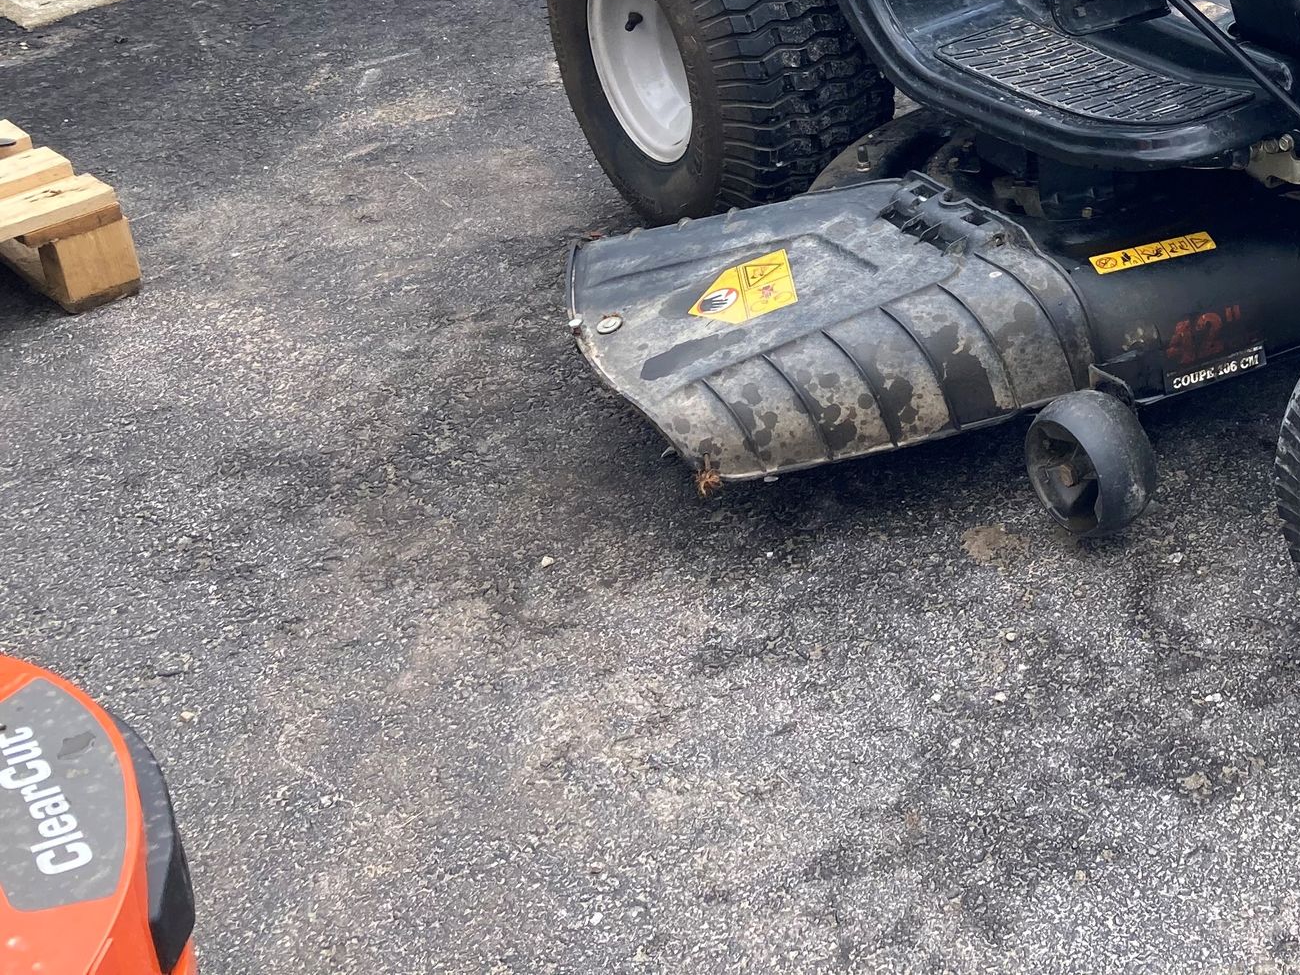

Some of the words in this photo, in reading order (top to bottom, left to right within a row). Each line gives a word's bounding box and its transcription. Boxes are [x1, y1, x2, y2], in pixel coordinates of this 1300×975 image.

[1173, 367, 1215, 389] COUPE
[1218, 360, 1238, 376] 106
[1240, 354, 1259, 370] CM
[0, 726, 93, 875] ClearCut
